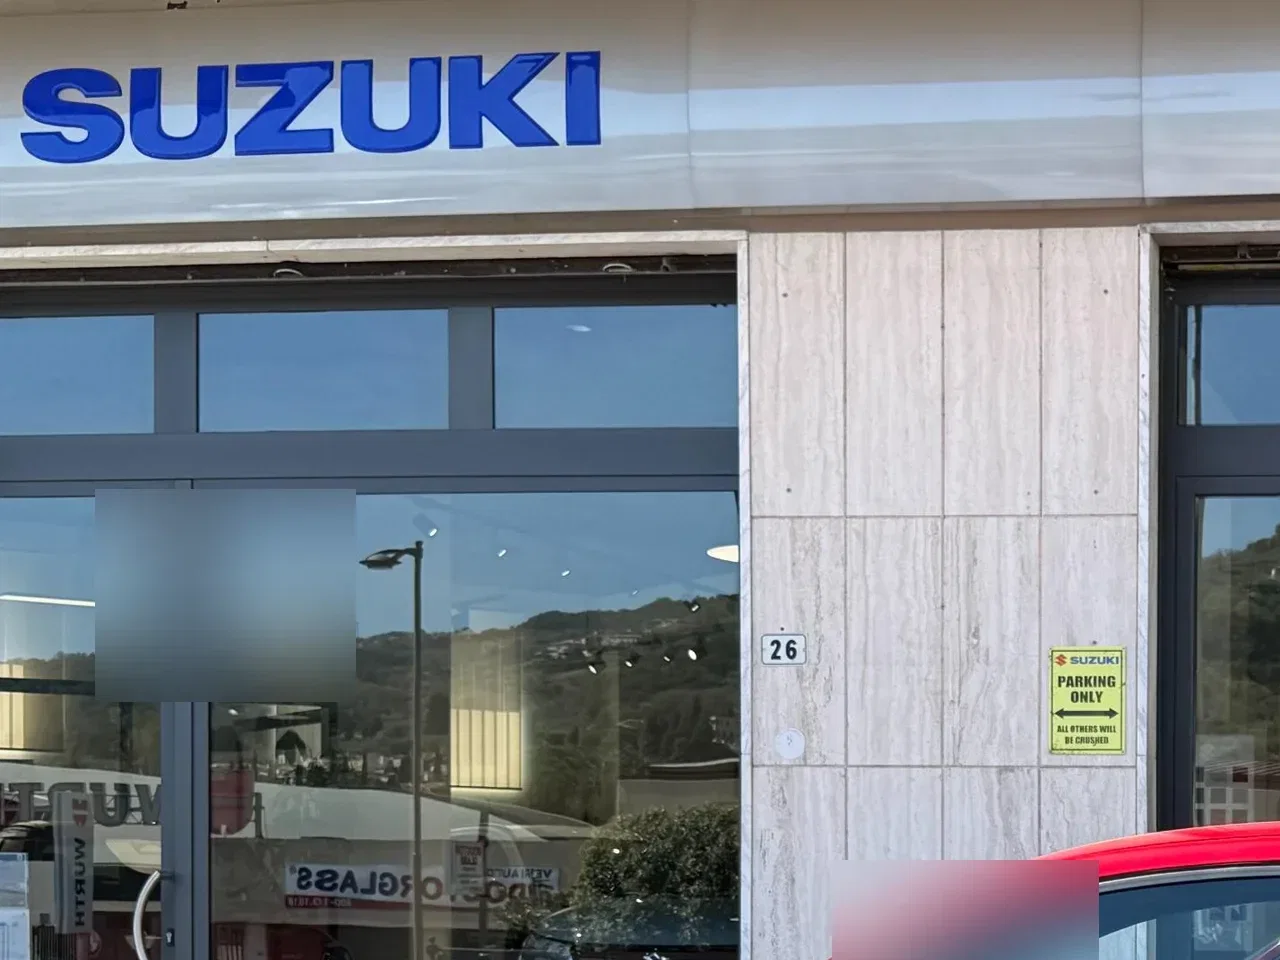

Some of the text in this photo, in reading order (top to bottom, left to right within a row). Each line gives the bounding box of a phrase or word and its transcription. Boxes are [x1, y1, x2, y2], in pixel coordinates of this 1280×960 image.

[20, 50, 602, 163] SUZUKI
[770, 639, 798, 660] 26
[1070, 656, 1119, 665] SUZUKI
[1057, 675, 1116, 688] PARKING
[1070, 691, 1104, 703] ONLY
[1057, 725, 1117, 733] ALL OTHERS WILL
[1064, 736, 1109, 745] BE CRUSHED
